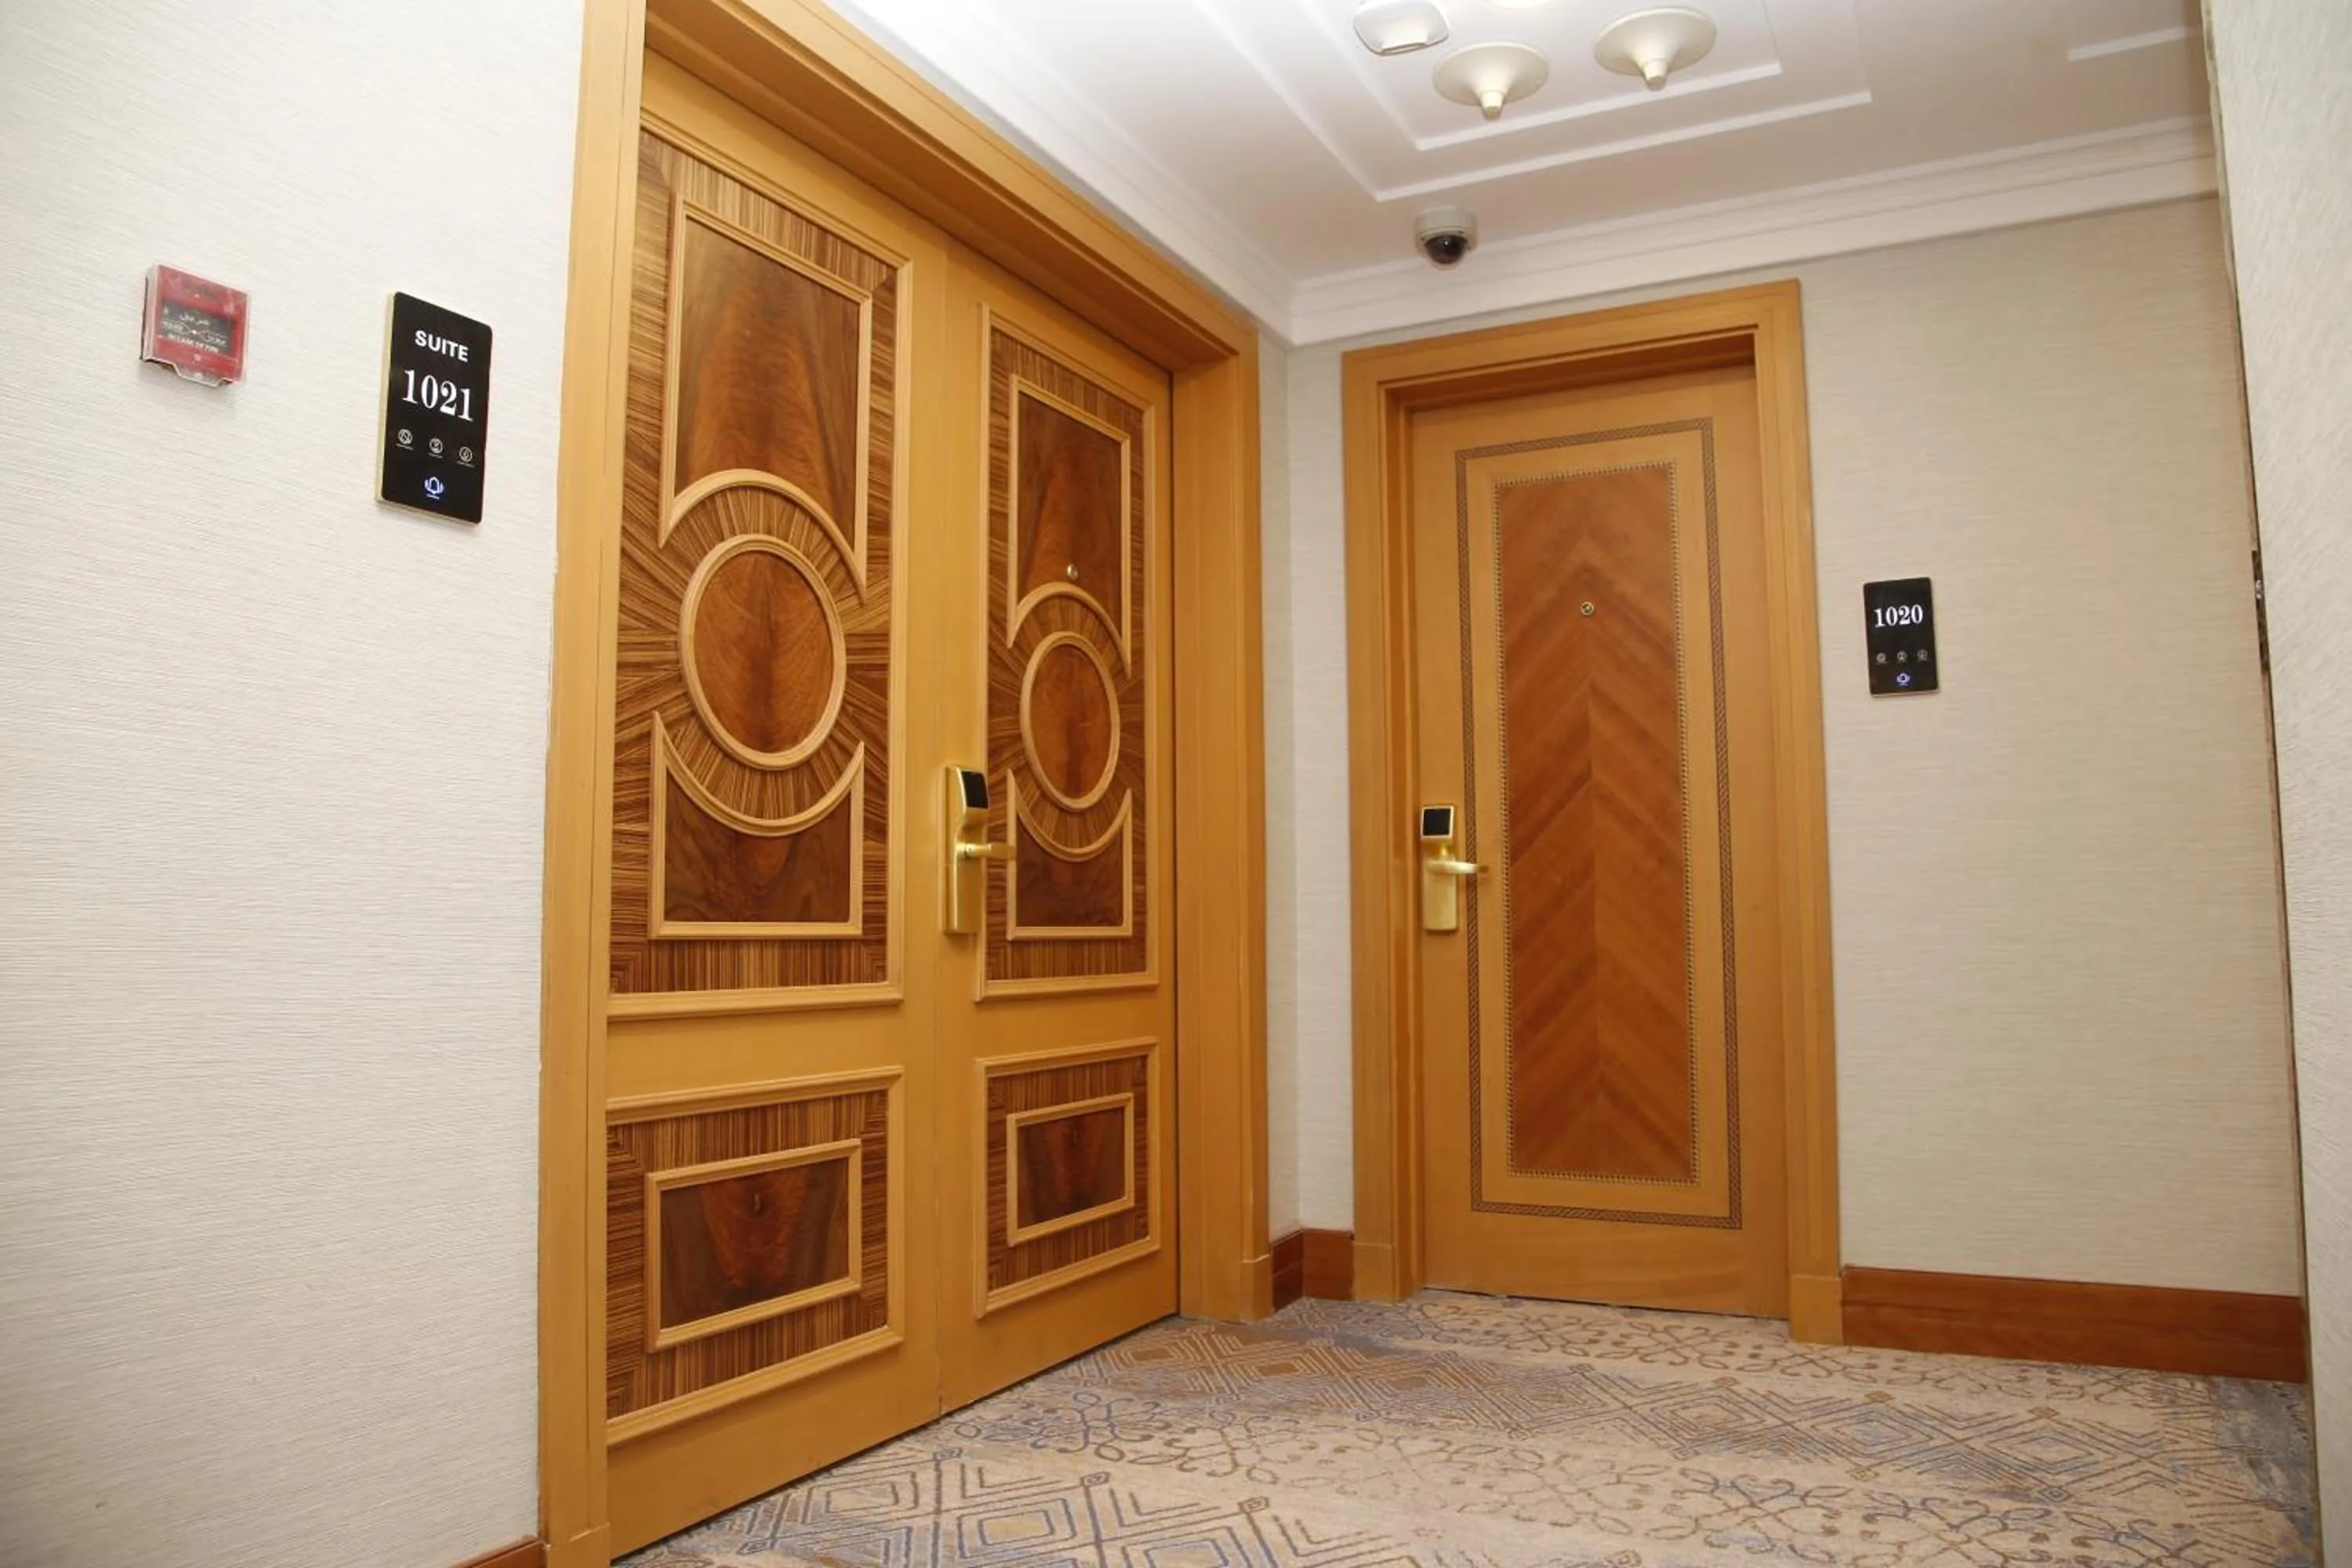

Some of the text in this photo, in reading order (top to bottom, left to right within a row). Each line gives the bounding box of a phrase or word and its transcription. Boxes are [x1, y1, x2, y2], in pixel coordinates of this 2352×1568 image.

[415, 329, 469, 363] SUITE
[402, 369, 474, 422] 1021
[1874, 604, 1923, 628] 1020
